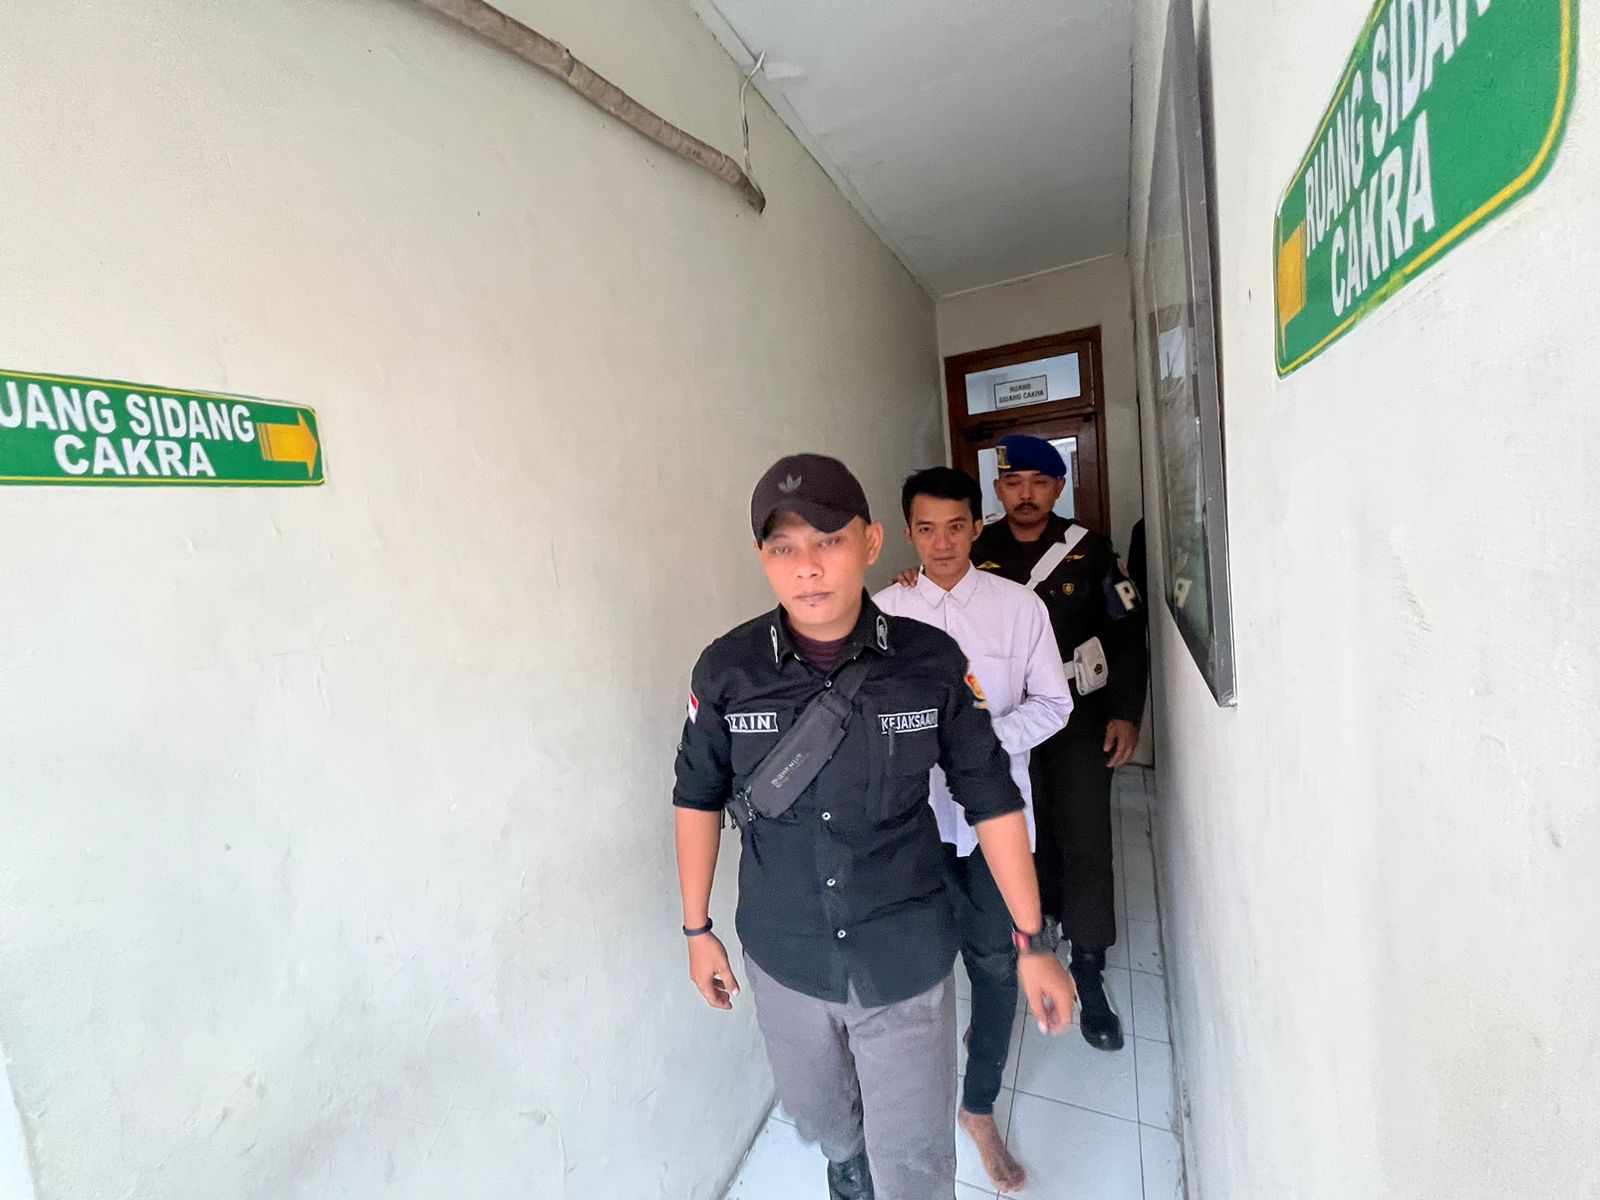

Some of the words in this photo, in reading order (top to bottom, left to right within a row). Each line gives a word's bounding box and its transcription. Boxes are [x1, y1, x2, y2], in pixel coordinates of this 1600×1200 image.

[1305, 70, 1363, 257] RUANG
[1331, 110, 1435, 317] CAKRA
[1009, 383, 1031, 393] RUANG
[1023, 389, 1044, 399] CAKRA
[125, 394, 255, 442] SIDANG
[54, 434, 216, 477] CAKRA
